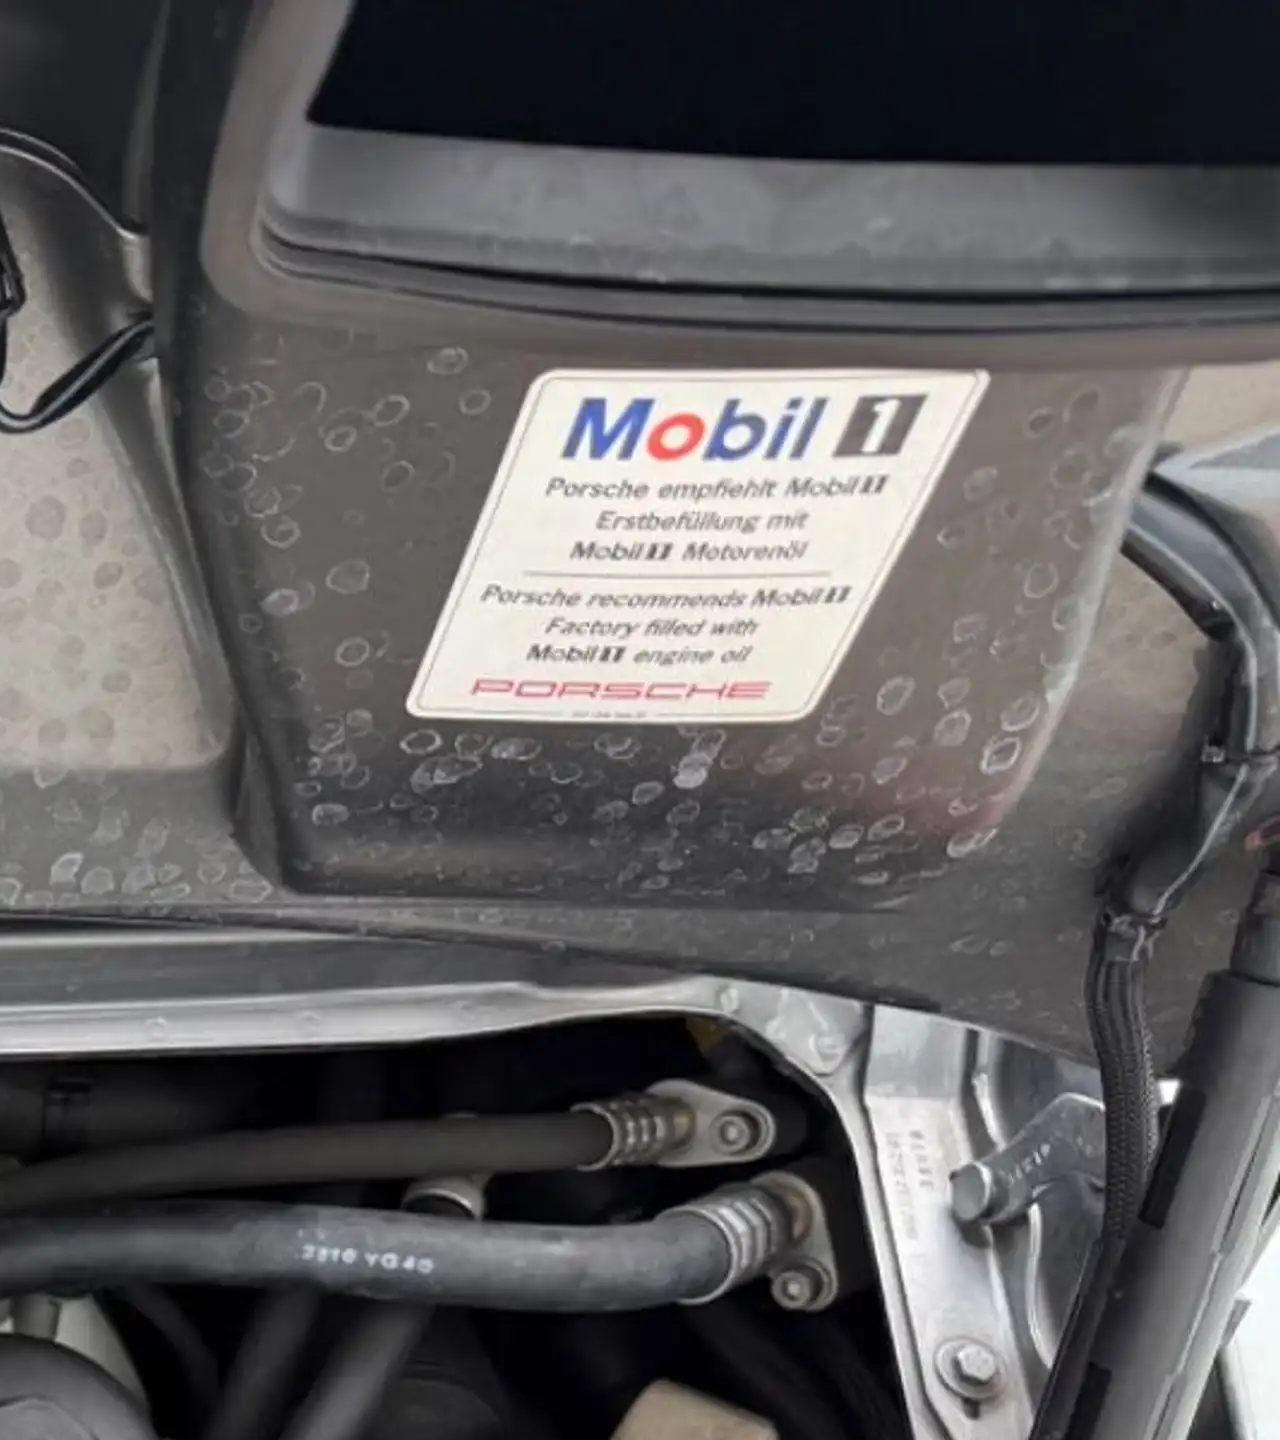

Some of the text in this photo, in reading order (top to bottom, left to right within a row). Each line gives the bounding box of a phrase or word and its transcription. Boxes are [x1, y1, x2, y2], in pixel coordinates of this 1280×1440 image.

[560, 396, 830, 462] Mobil
[545, 476, 649, 499] Porsche
[658, 476, 778, 502] empfiehlt
[596, 510, 810, 534] Erstbefüllung mit
[681, 540, 809, 562] Motorenöl
[480, 584, 582, 608] Porsche
[586, 588, 751, 610] recommends
[545, 616, 759, 640] Factory filled with
[633, 647, 715, 667] engine
[721, 644, 754, 665] oil
[470, 678, 773, 700] PORSCHE
